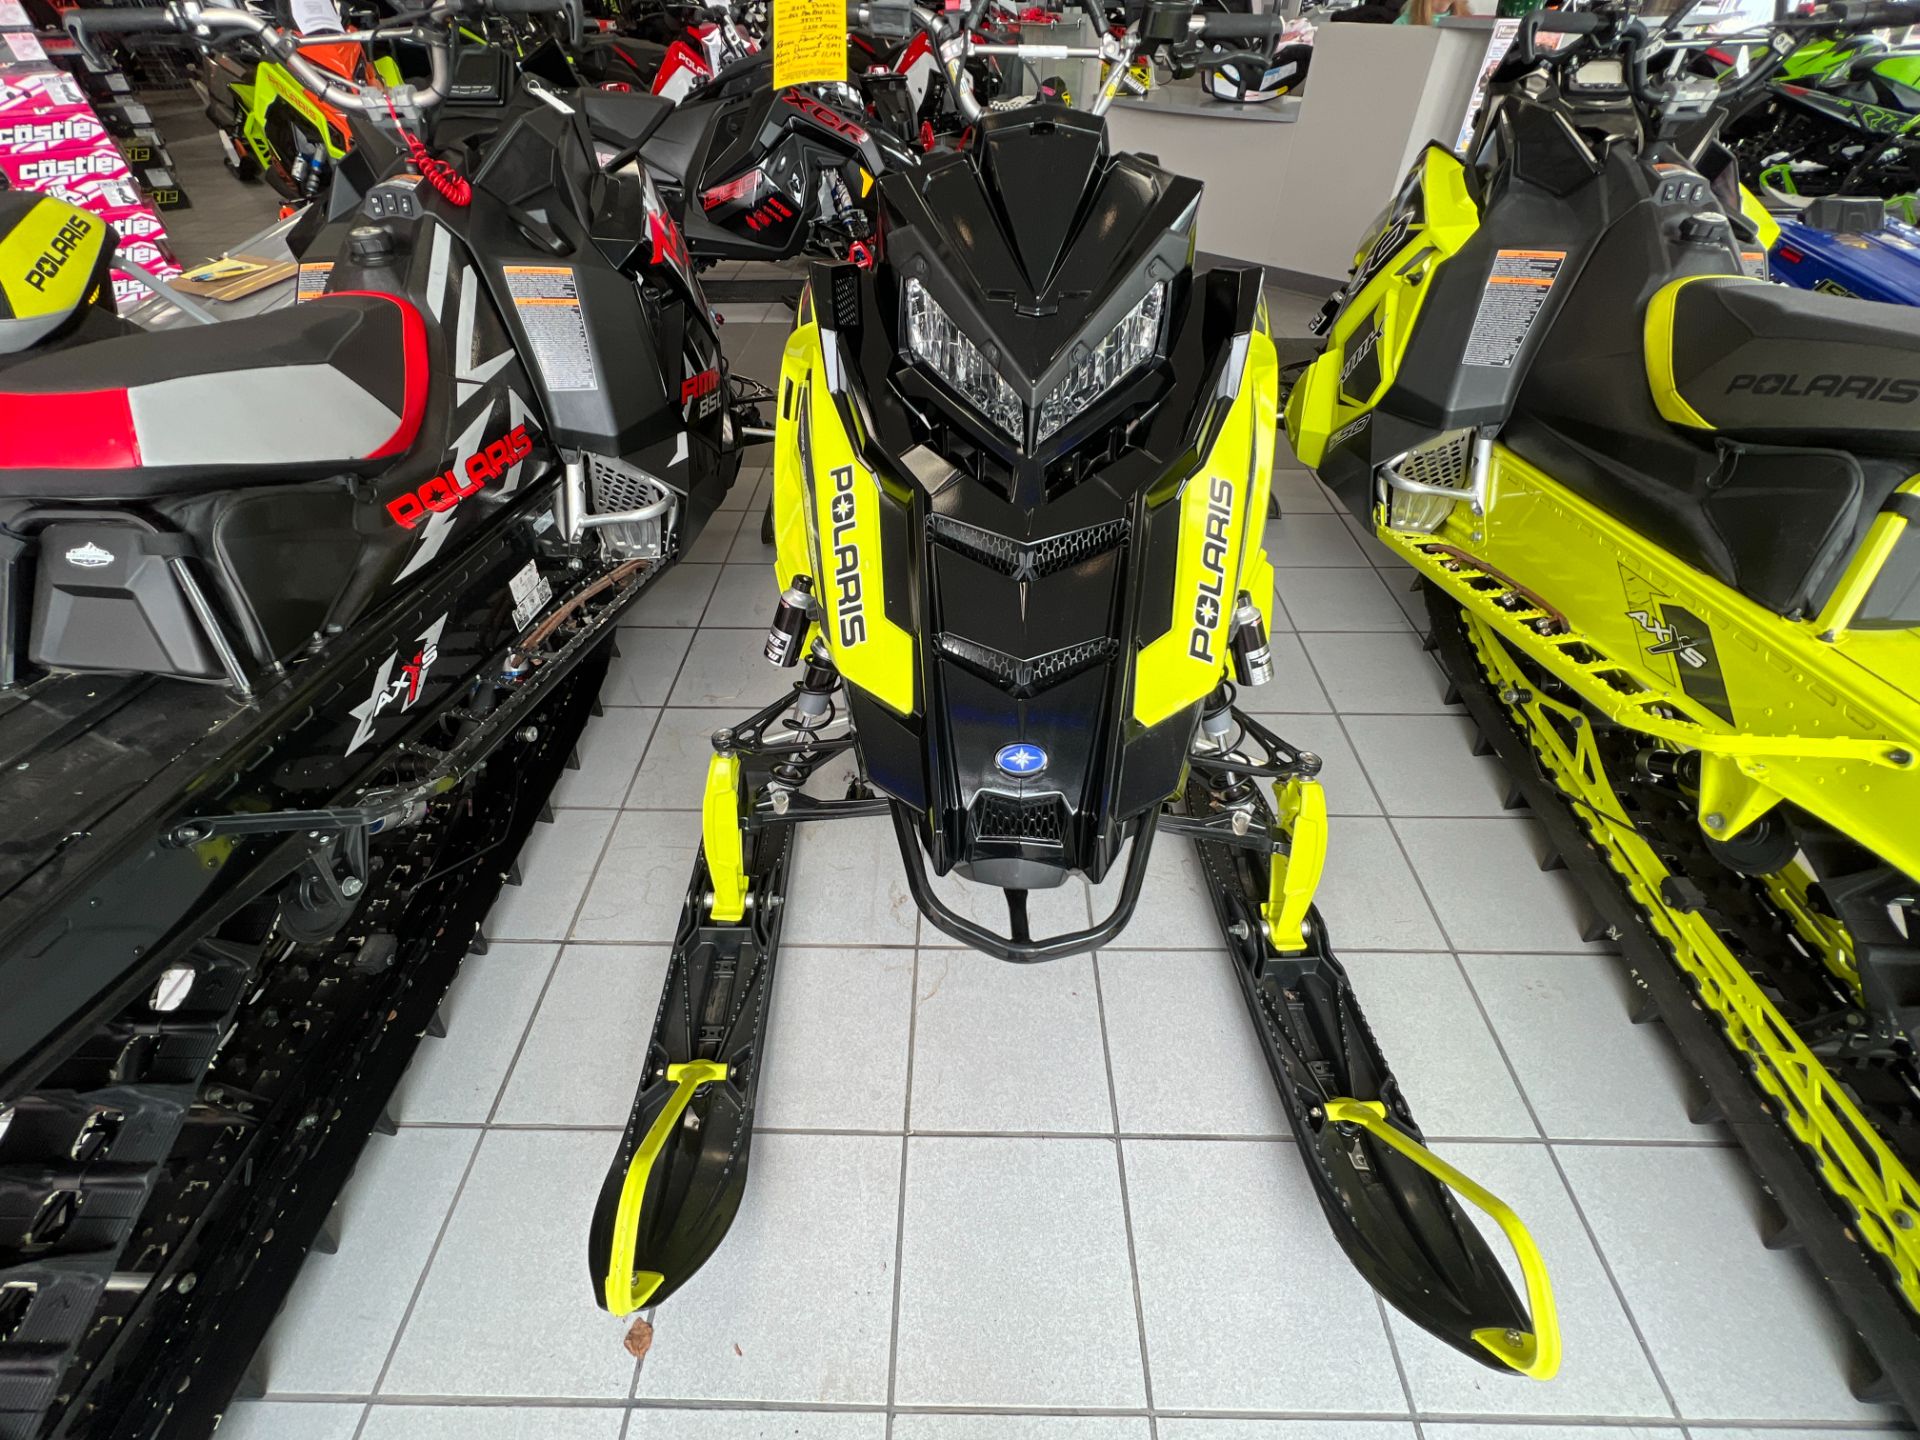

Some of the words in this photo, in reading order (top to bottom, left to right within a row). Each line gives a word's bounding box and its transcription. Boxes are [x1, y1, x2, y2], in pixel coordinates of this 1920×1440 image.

[678, 51, 708, 76] POLA
[782, 88, 869, 144] XCR
[19, 155, 115, 180] castle
[24, 214, 91, 292] POLARIS
[112, 218, 151, 236] tle
[1725, 374, 1920, 403] POLARIS
[386, 424, 533, 530] POLARIS
[830, 464, 867, 649] POLARIS
[1188, 476, 1233, 663] POLARIS
